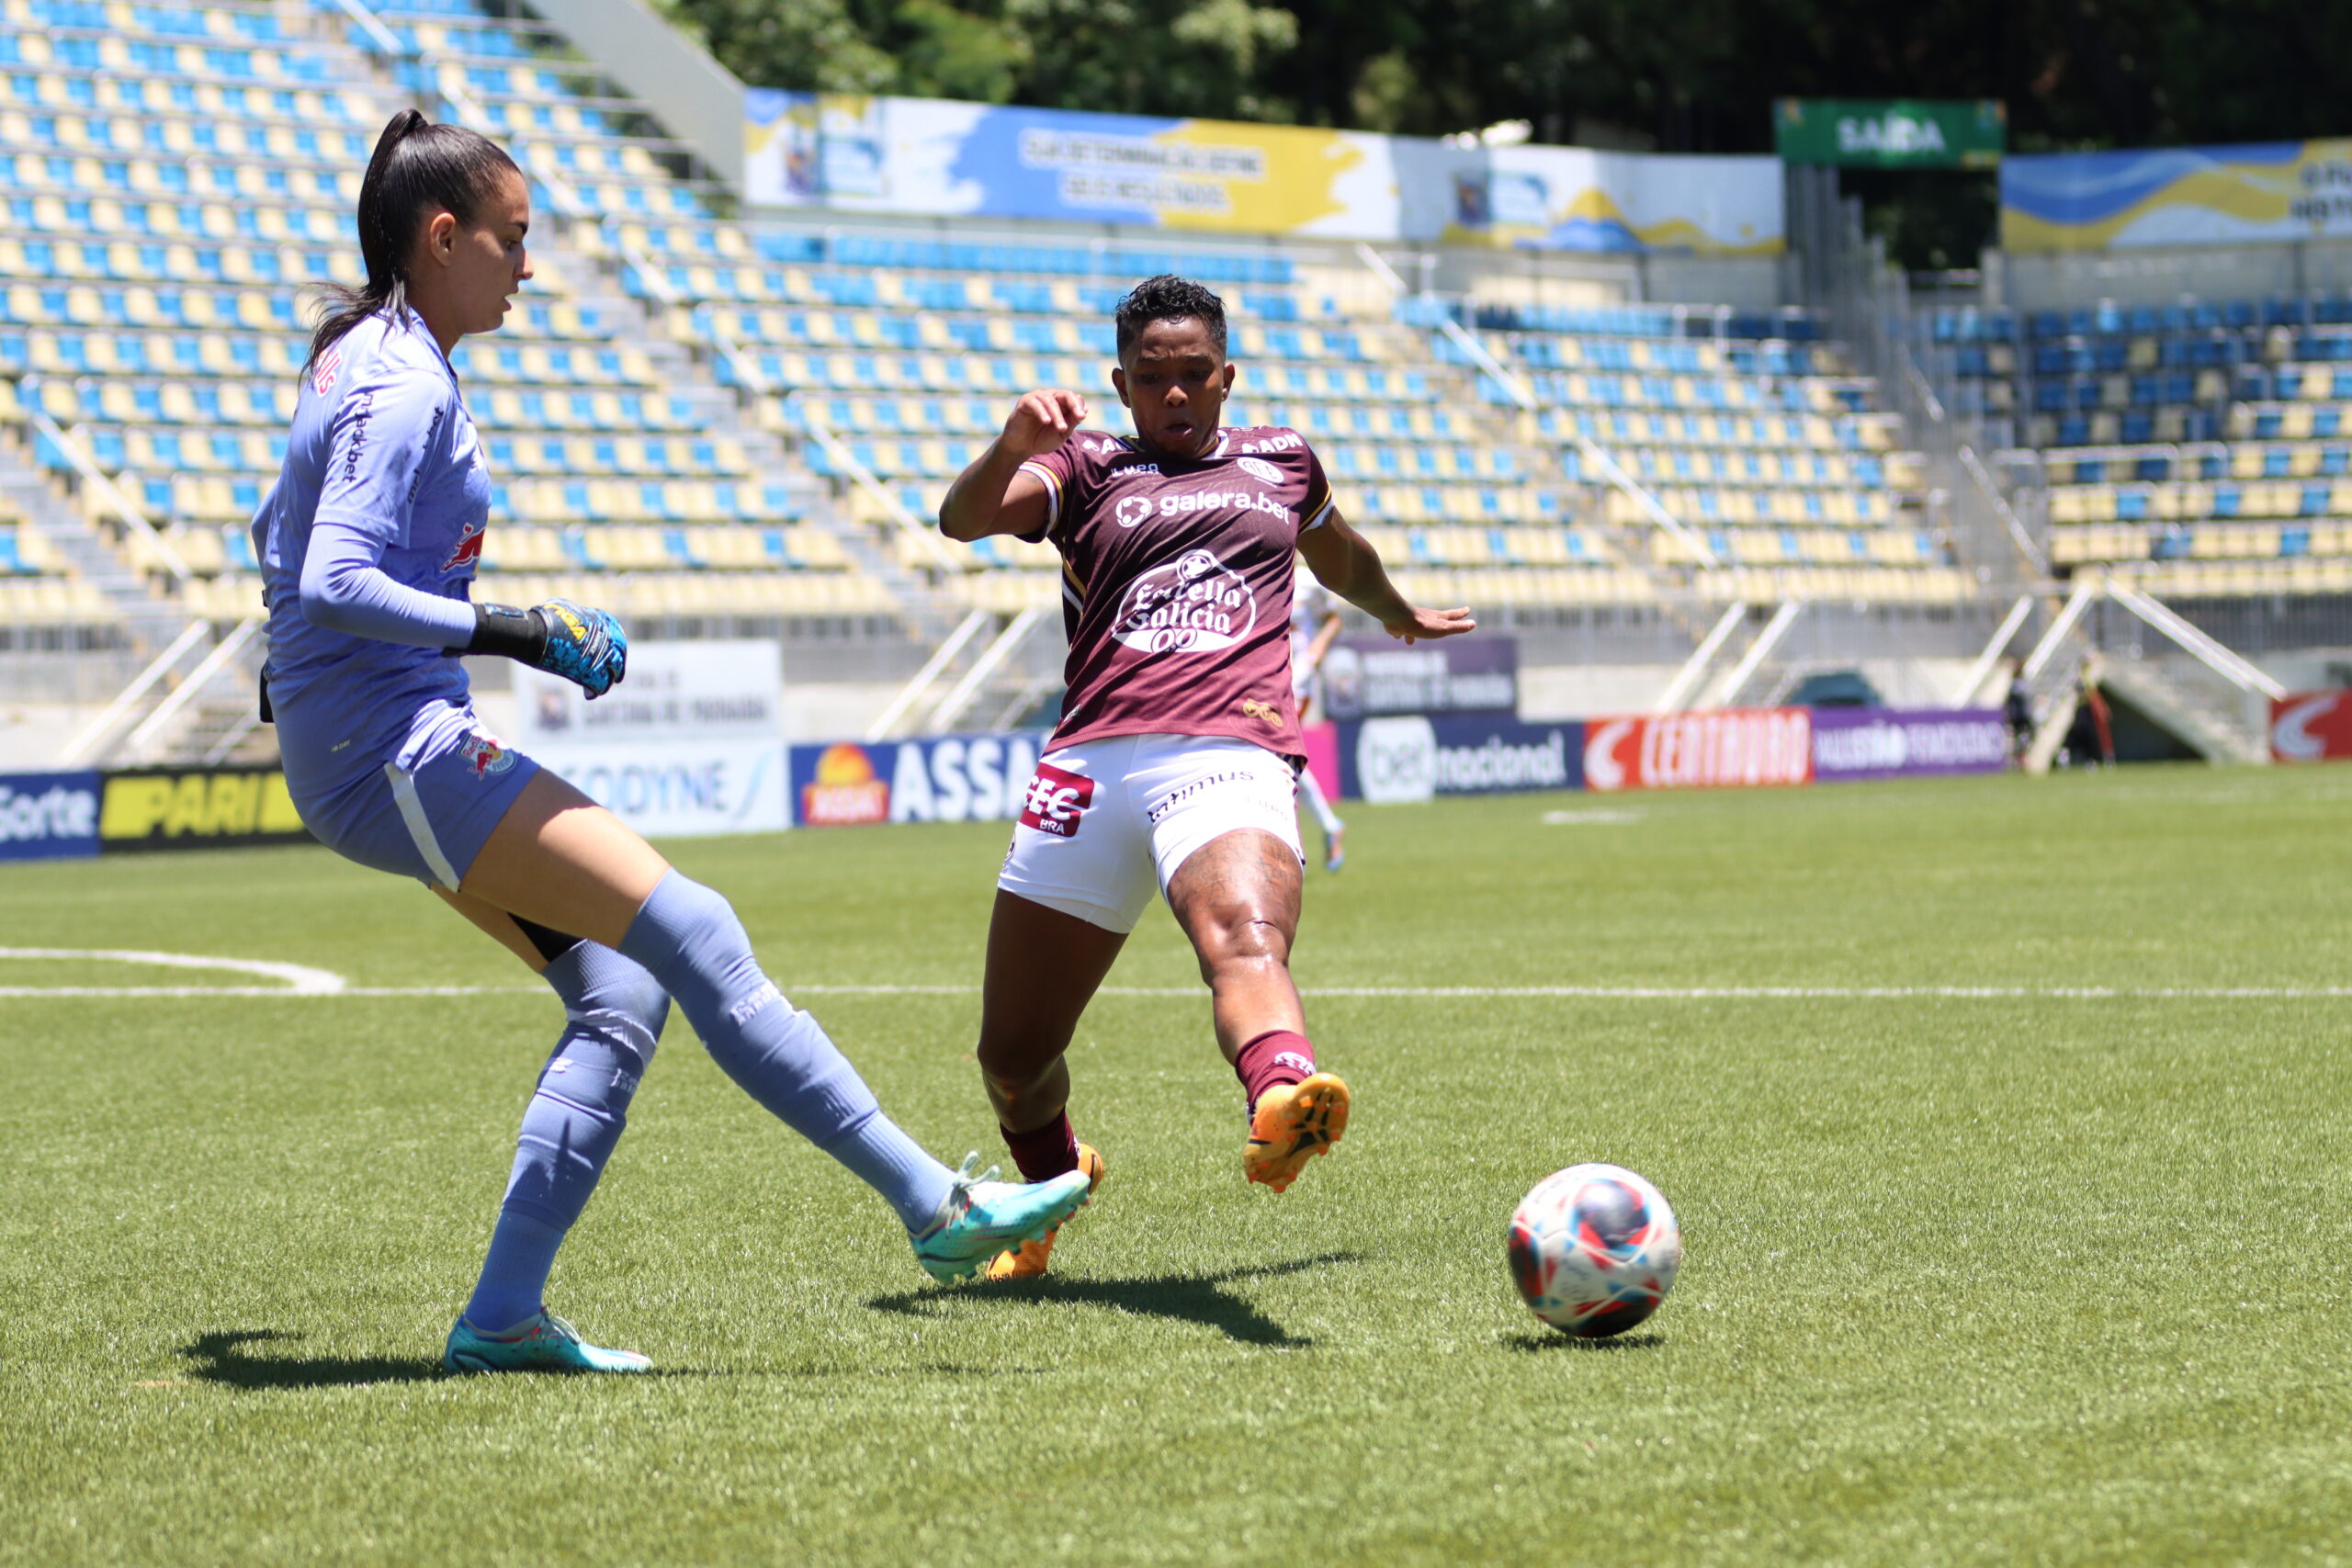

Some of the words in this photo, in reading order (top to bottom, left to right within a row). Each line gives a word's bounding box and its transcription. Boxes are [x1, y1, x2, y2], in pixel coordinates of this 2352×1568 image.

[1837, 109, 1946, 153] SAÍDA
[1159, 491, 1290, 525] galera.bet
[1039, 818, 1065, 834] BRA
